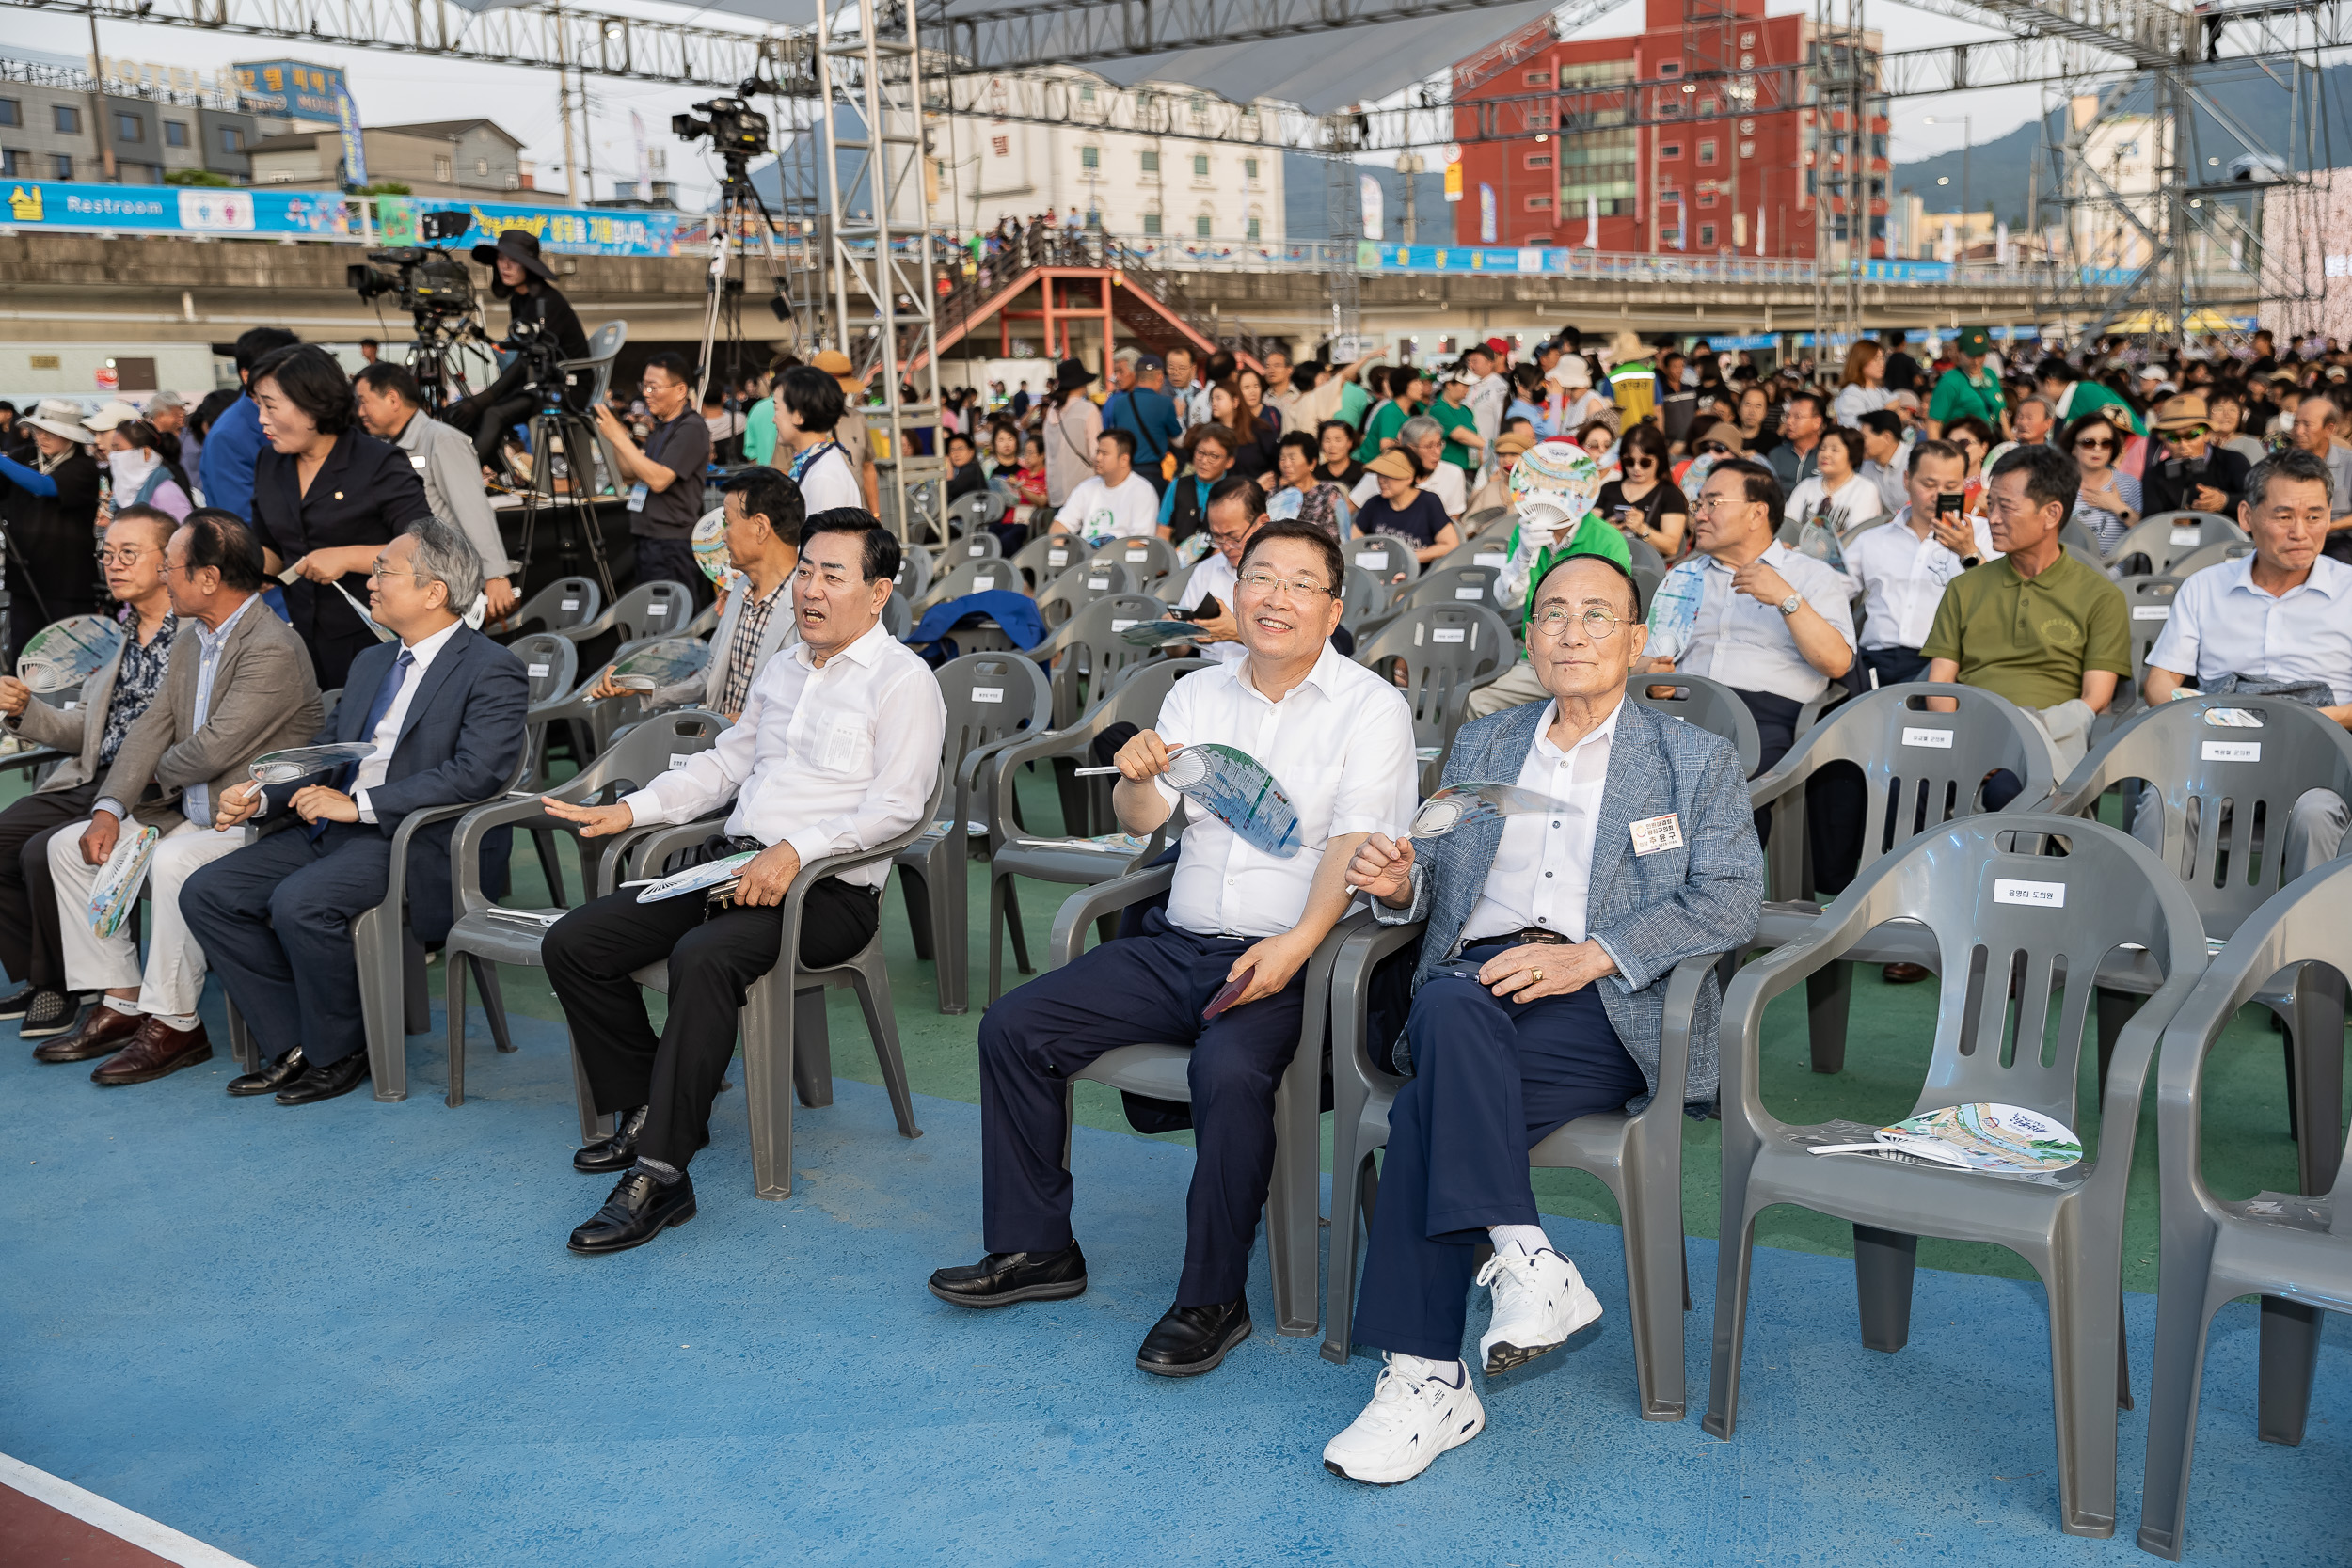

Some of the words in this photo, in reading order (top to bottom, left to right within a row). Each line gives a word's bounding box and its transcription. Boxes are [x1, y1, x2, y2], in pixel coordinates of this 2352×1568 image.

[8, 185, 44, 221] 실
[66, 195, 163, 215] Restroom
[2032, 891, 2054, 899] 도의원
